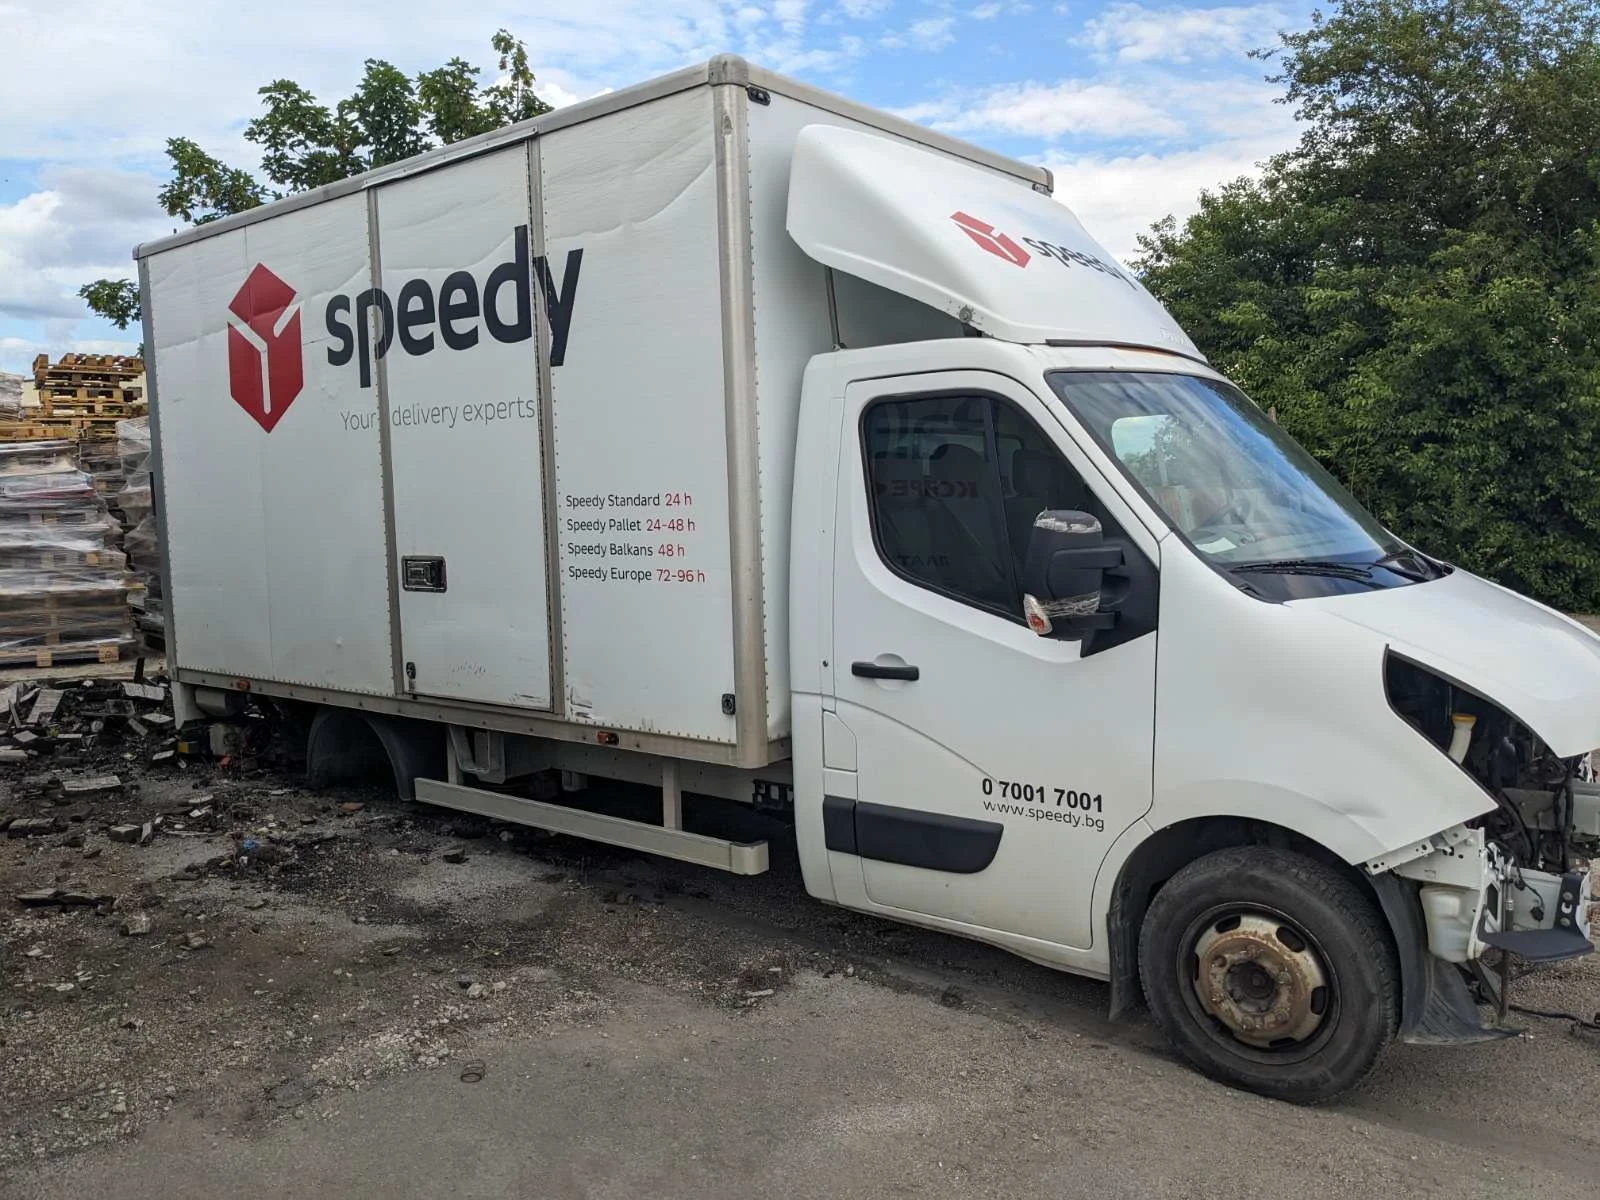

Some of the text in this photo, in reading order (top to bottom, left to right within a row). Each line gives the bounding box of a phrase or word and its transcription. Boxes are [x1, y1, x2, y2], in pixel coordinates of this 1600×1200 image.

[325, 223, 584, 389] speedy
[340, 395, 536, 432] Your delivery experts
[566, 492, 692, 510] Speedy Standard 24 h
[567, 518, 696, 534] Speedy Pallet 24-48 h
[567, 541, 685, 558] Speedy Balkans 48 h
[568, 565, 705, 583] Speedy Europe 72-96 h
[982, 778, 1103, 813] 0 7001 7001
[983, 800, 1105, 832] www.speedy.bg
